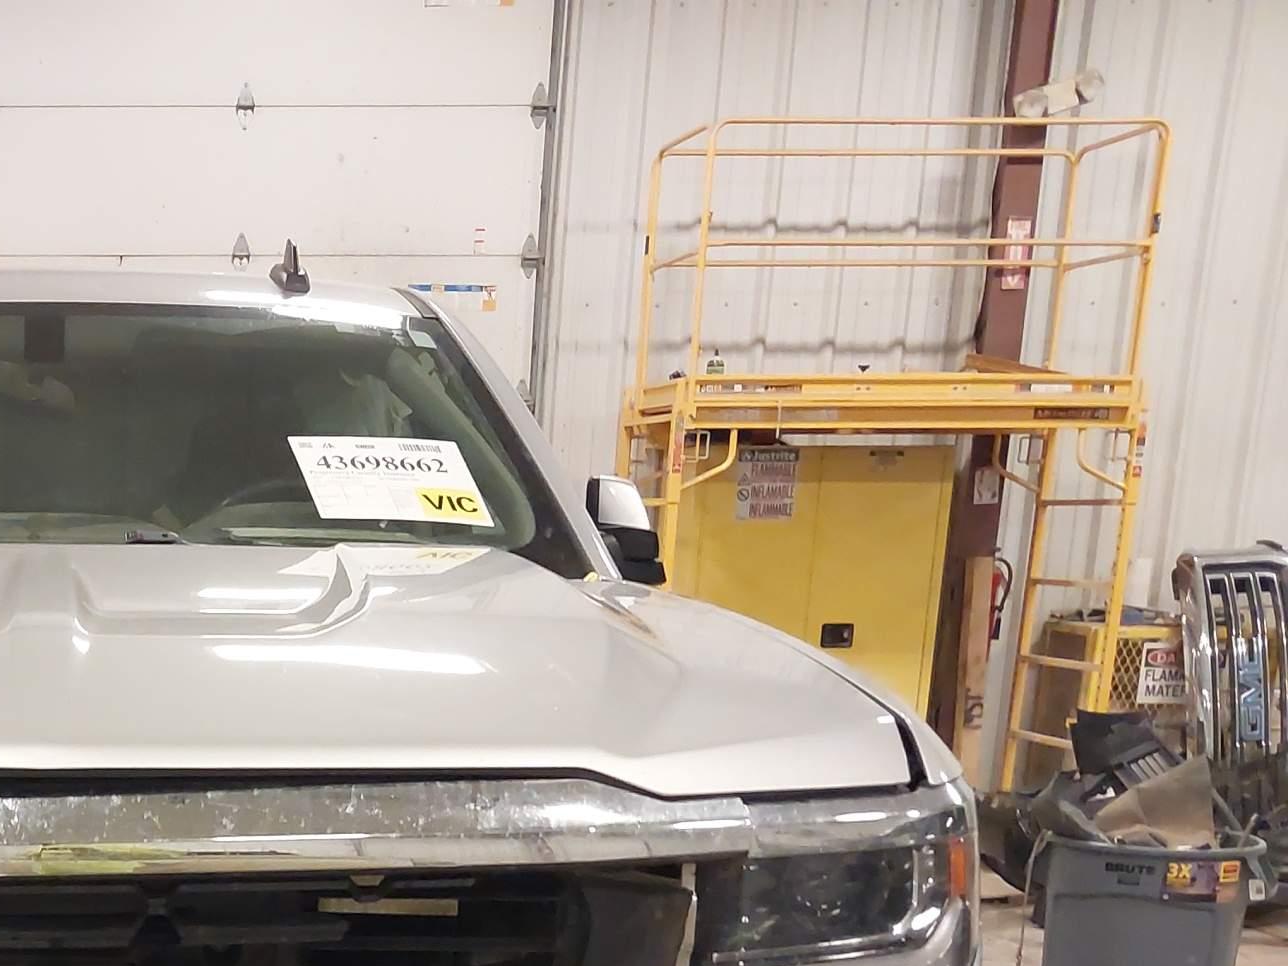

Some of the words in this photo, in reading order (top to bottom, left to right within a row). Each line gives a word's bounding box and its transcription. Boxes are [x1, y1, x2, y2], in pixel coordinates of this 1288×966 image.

[316, 454, 448, 474] 43698662
[754, 451, 796, 462] Justrite
[422, 493, 479, 513] VIC
[1104, 861, 1156, 875] BRUTE
[1167, 862, 1192, 879] 3X
